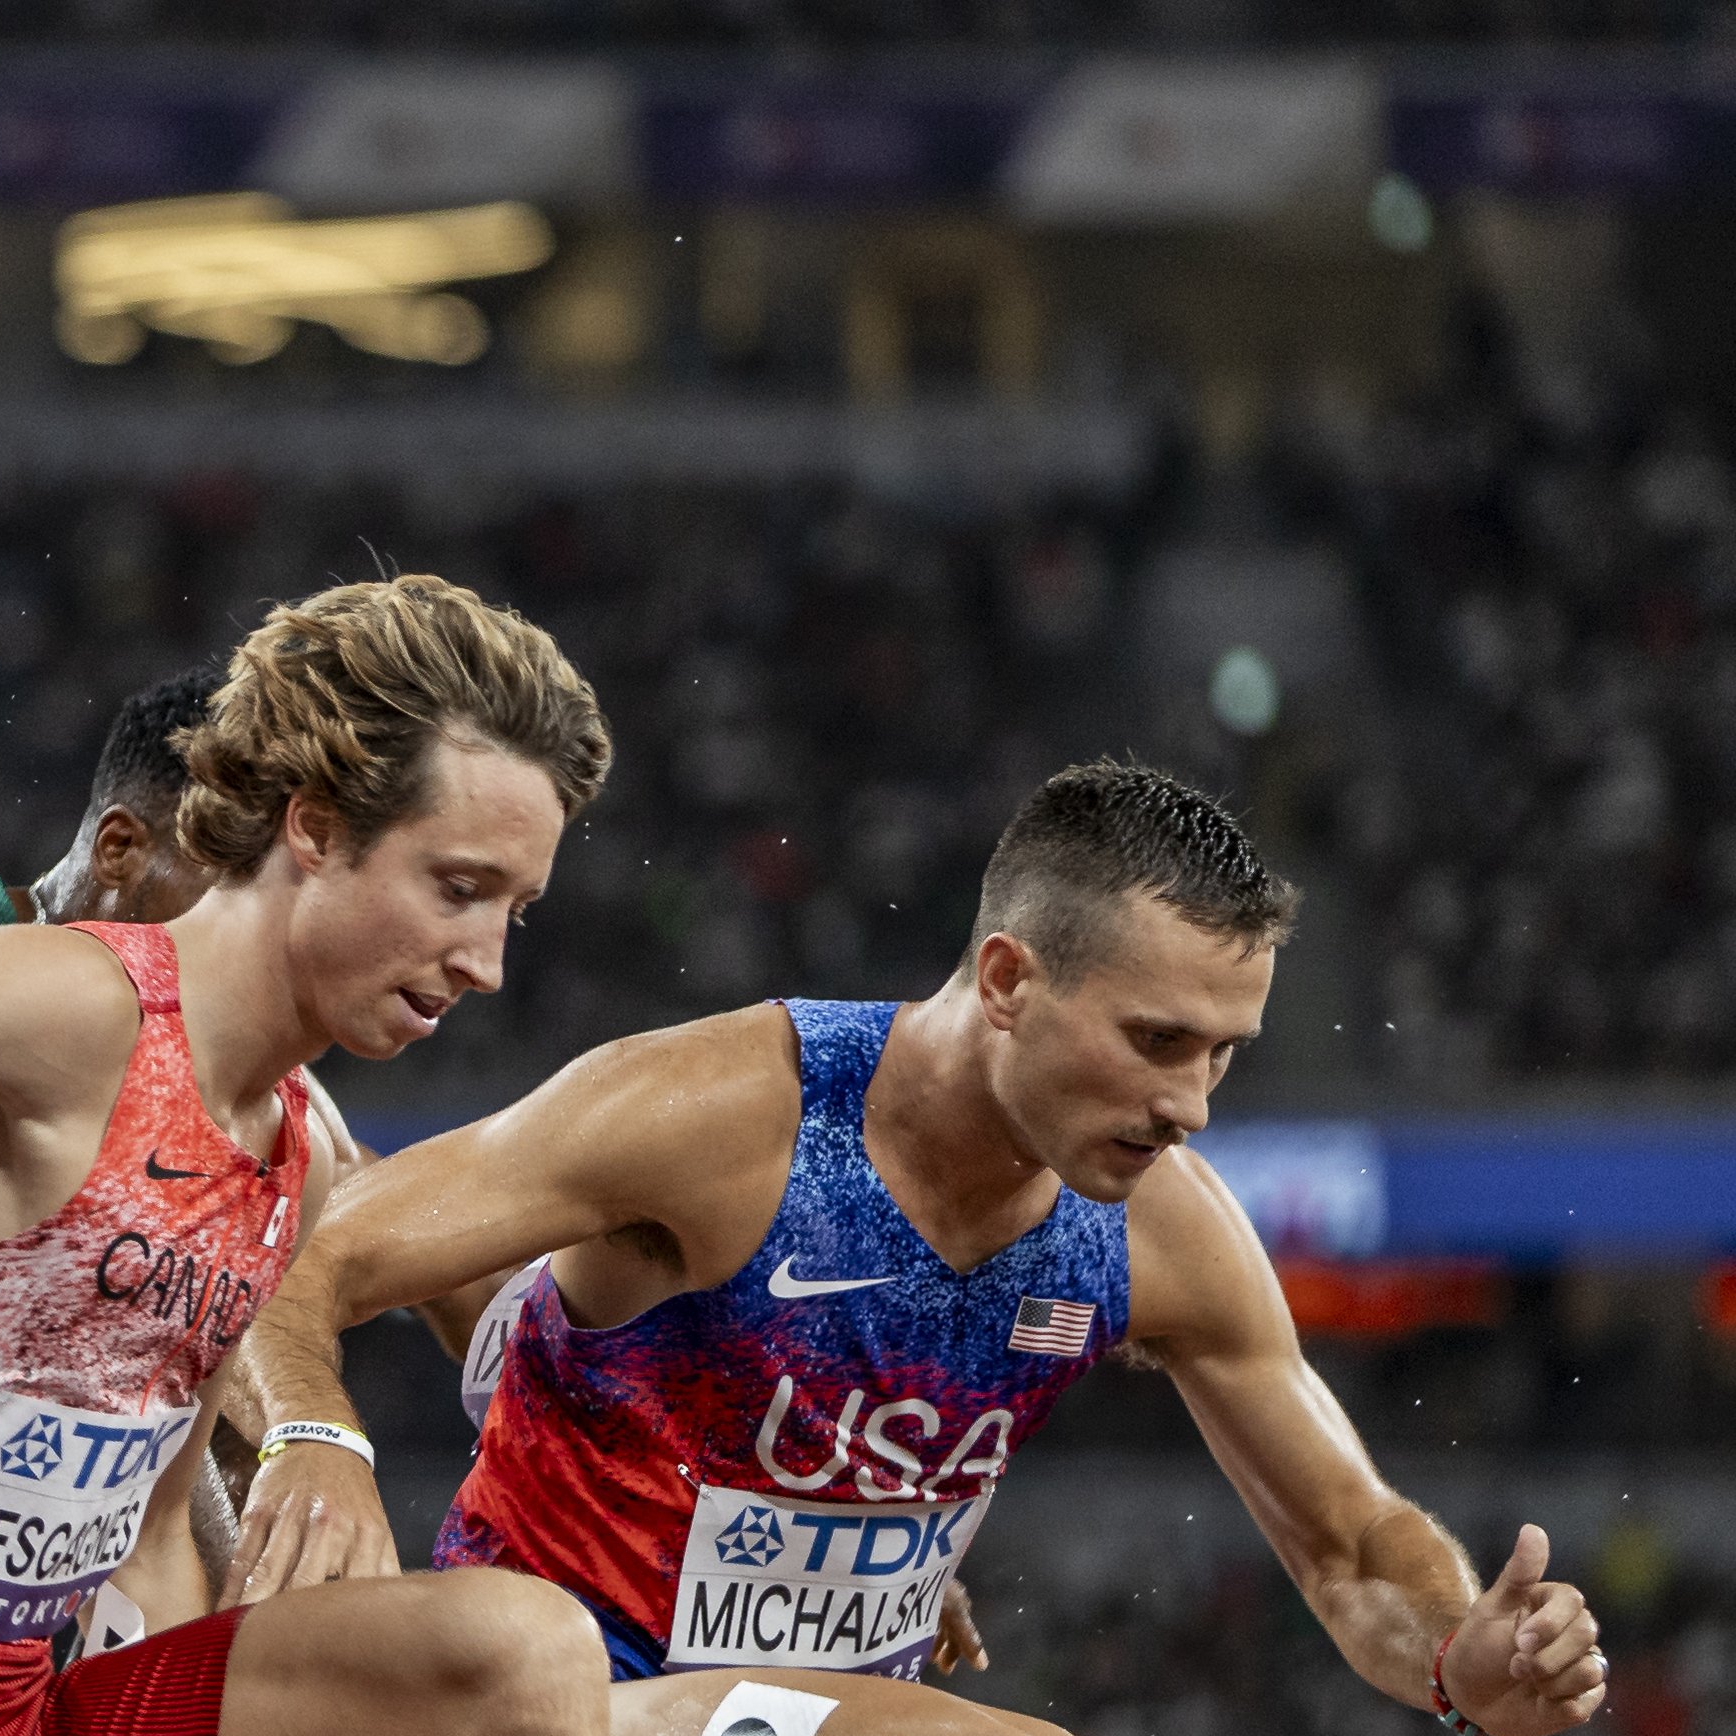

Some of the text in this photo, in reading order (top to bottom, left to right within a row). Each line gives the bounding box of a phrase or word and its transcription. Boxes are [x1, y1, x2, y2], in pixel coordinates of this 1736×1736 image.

[96, 1231, 262, 1345] CANAD
[73, 1417, 192, 1489] TDK
[755, 1374, 1015, 1502] USA
[791, 1502, 975, 1577] TDK
[686, 1566, 950, 1654] MICHALSKI
